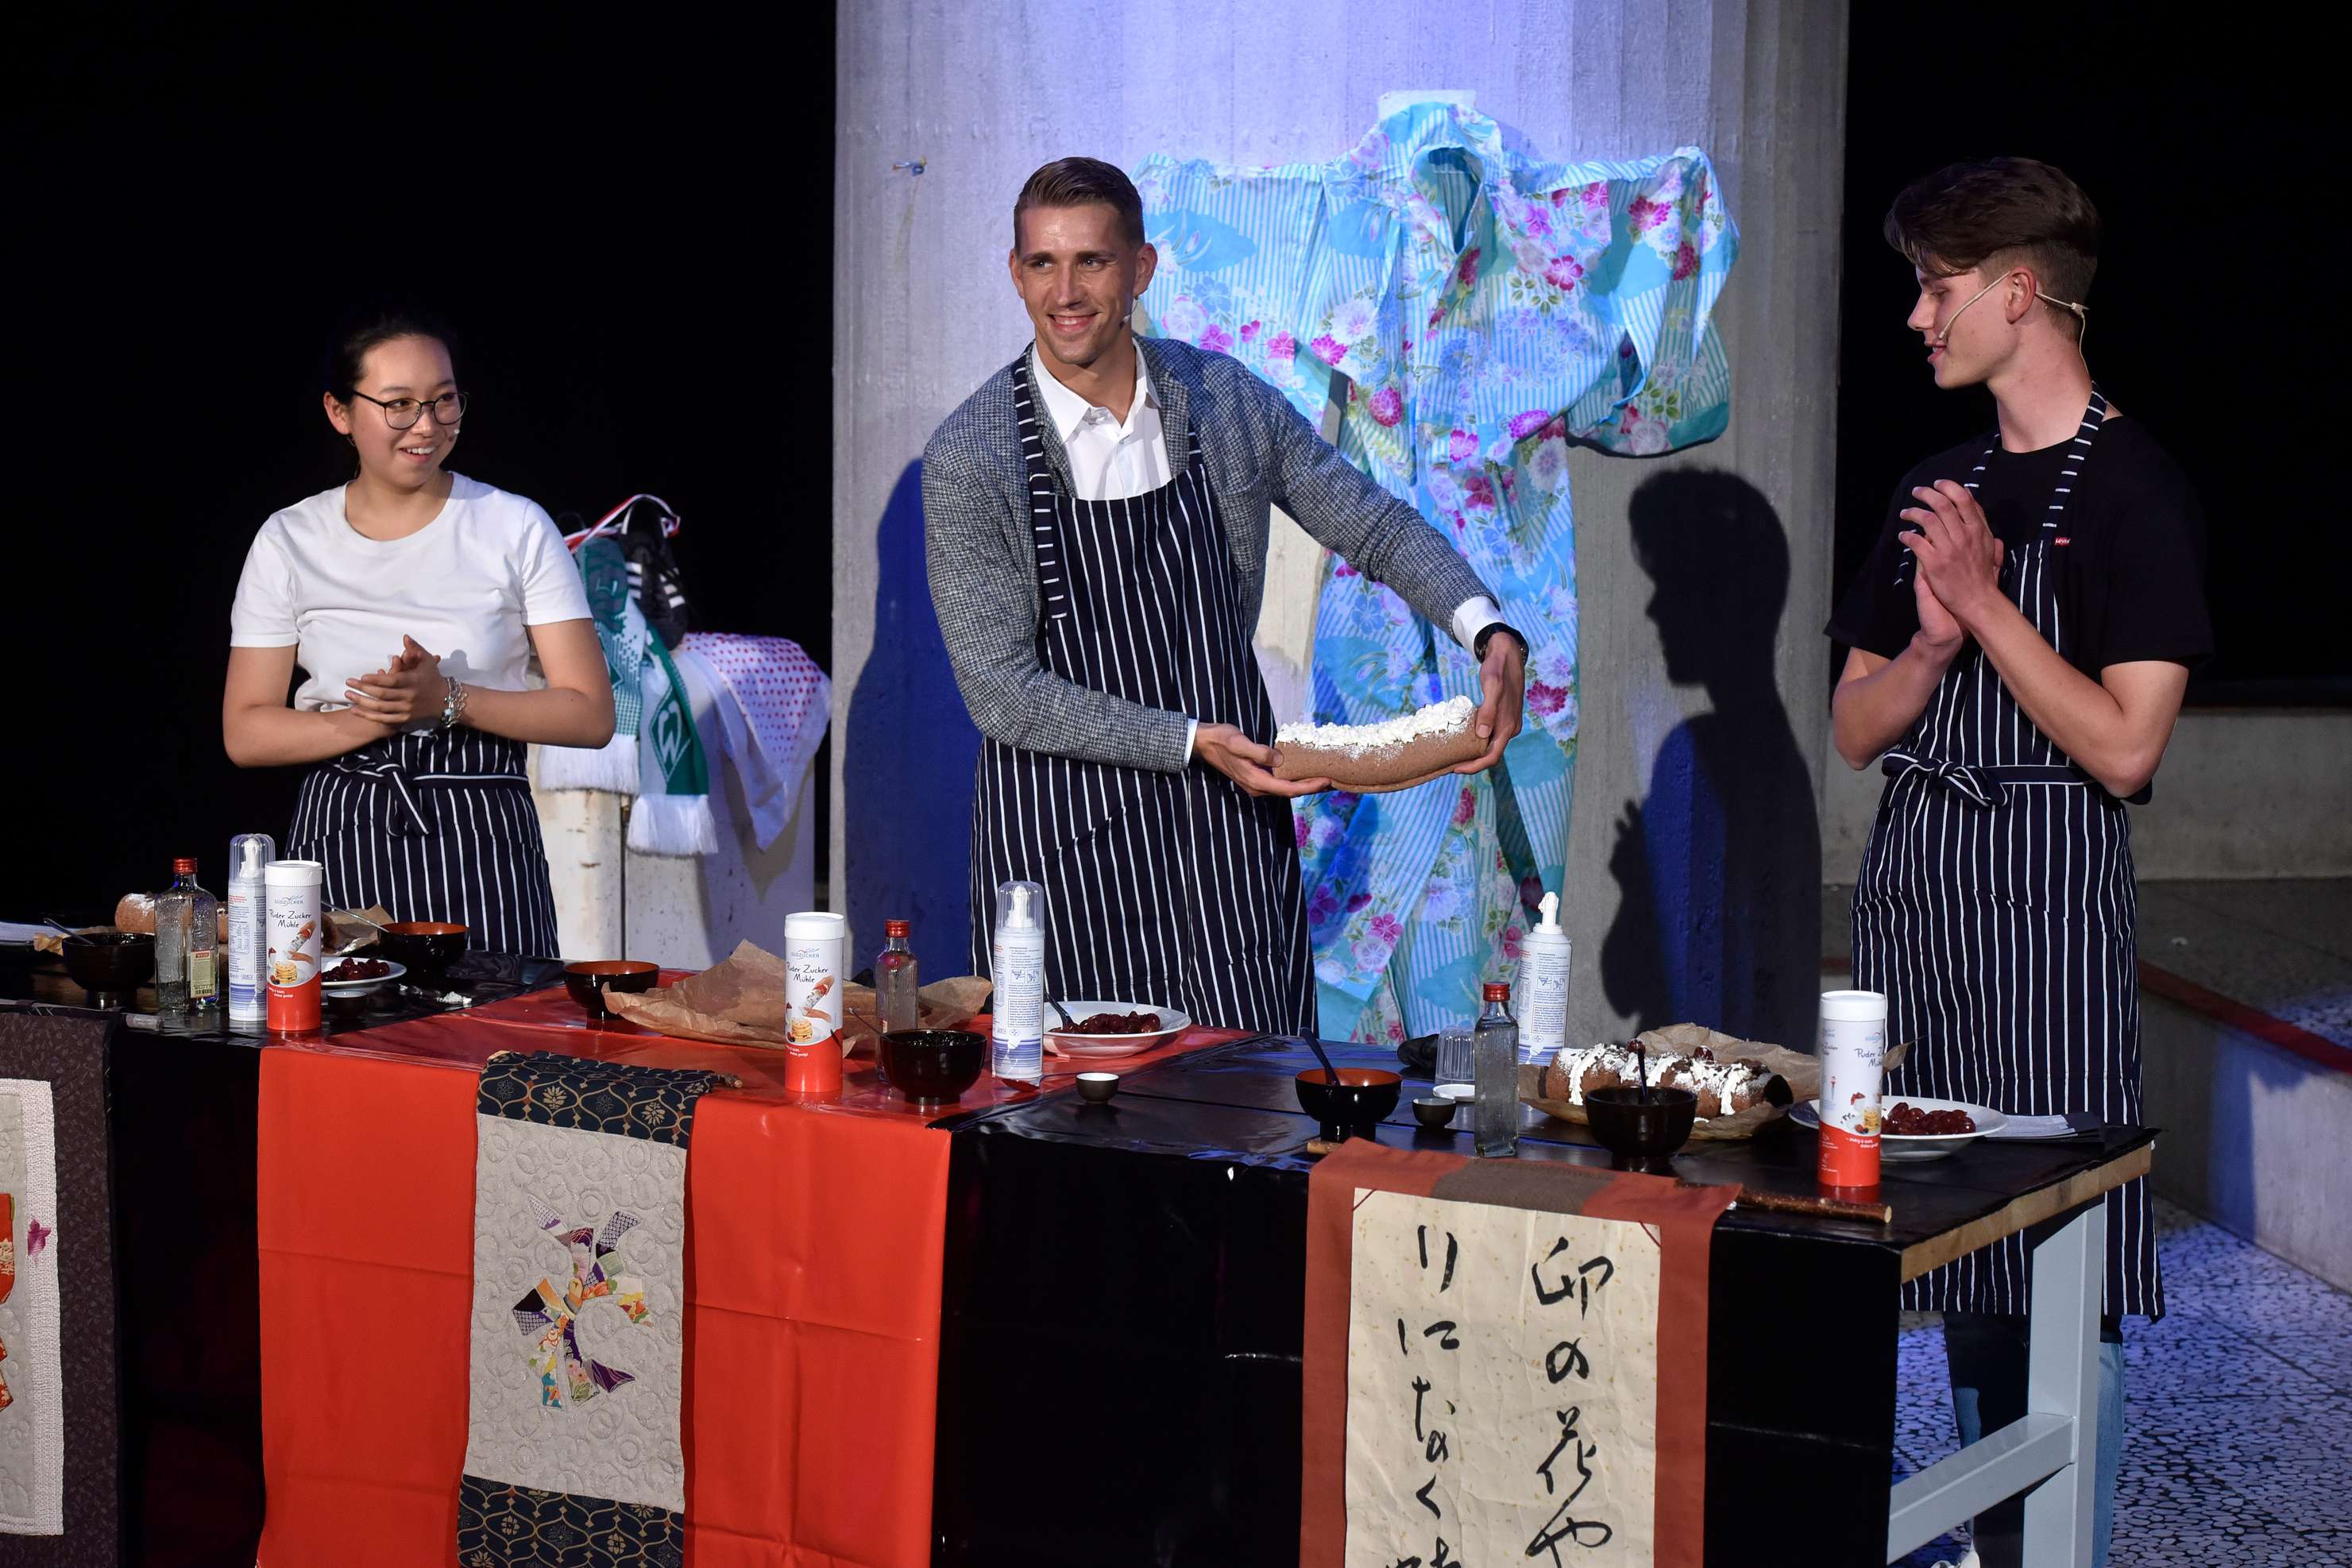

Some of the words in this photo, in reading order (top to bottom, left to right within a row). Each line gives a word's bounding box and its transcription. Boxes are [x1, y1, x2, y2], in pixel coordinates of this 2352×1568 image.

[268, 909, 285, 919] Puder
[288, 910, 311, 919] Zucker
[803, 964, 828, 973] Zucker
[794, 973, 815, 983] Mühle
[1854, 1048, 1875, 1058] Puder
